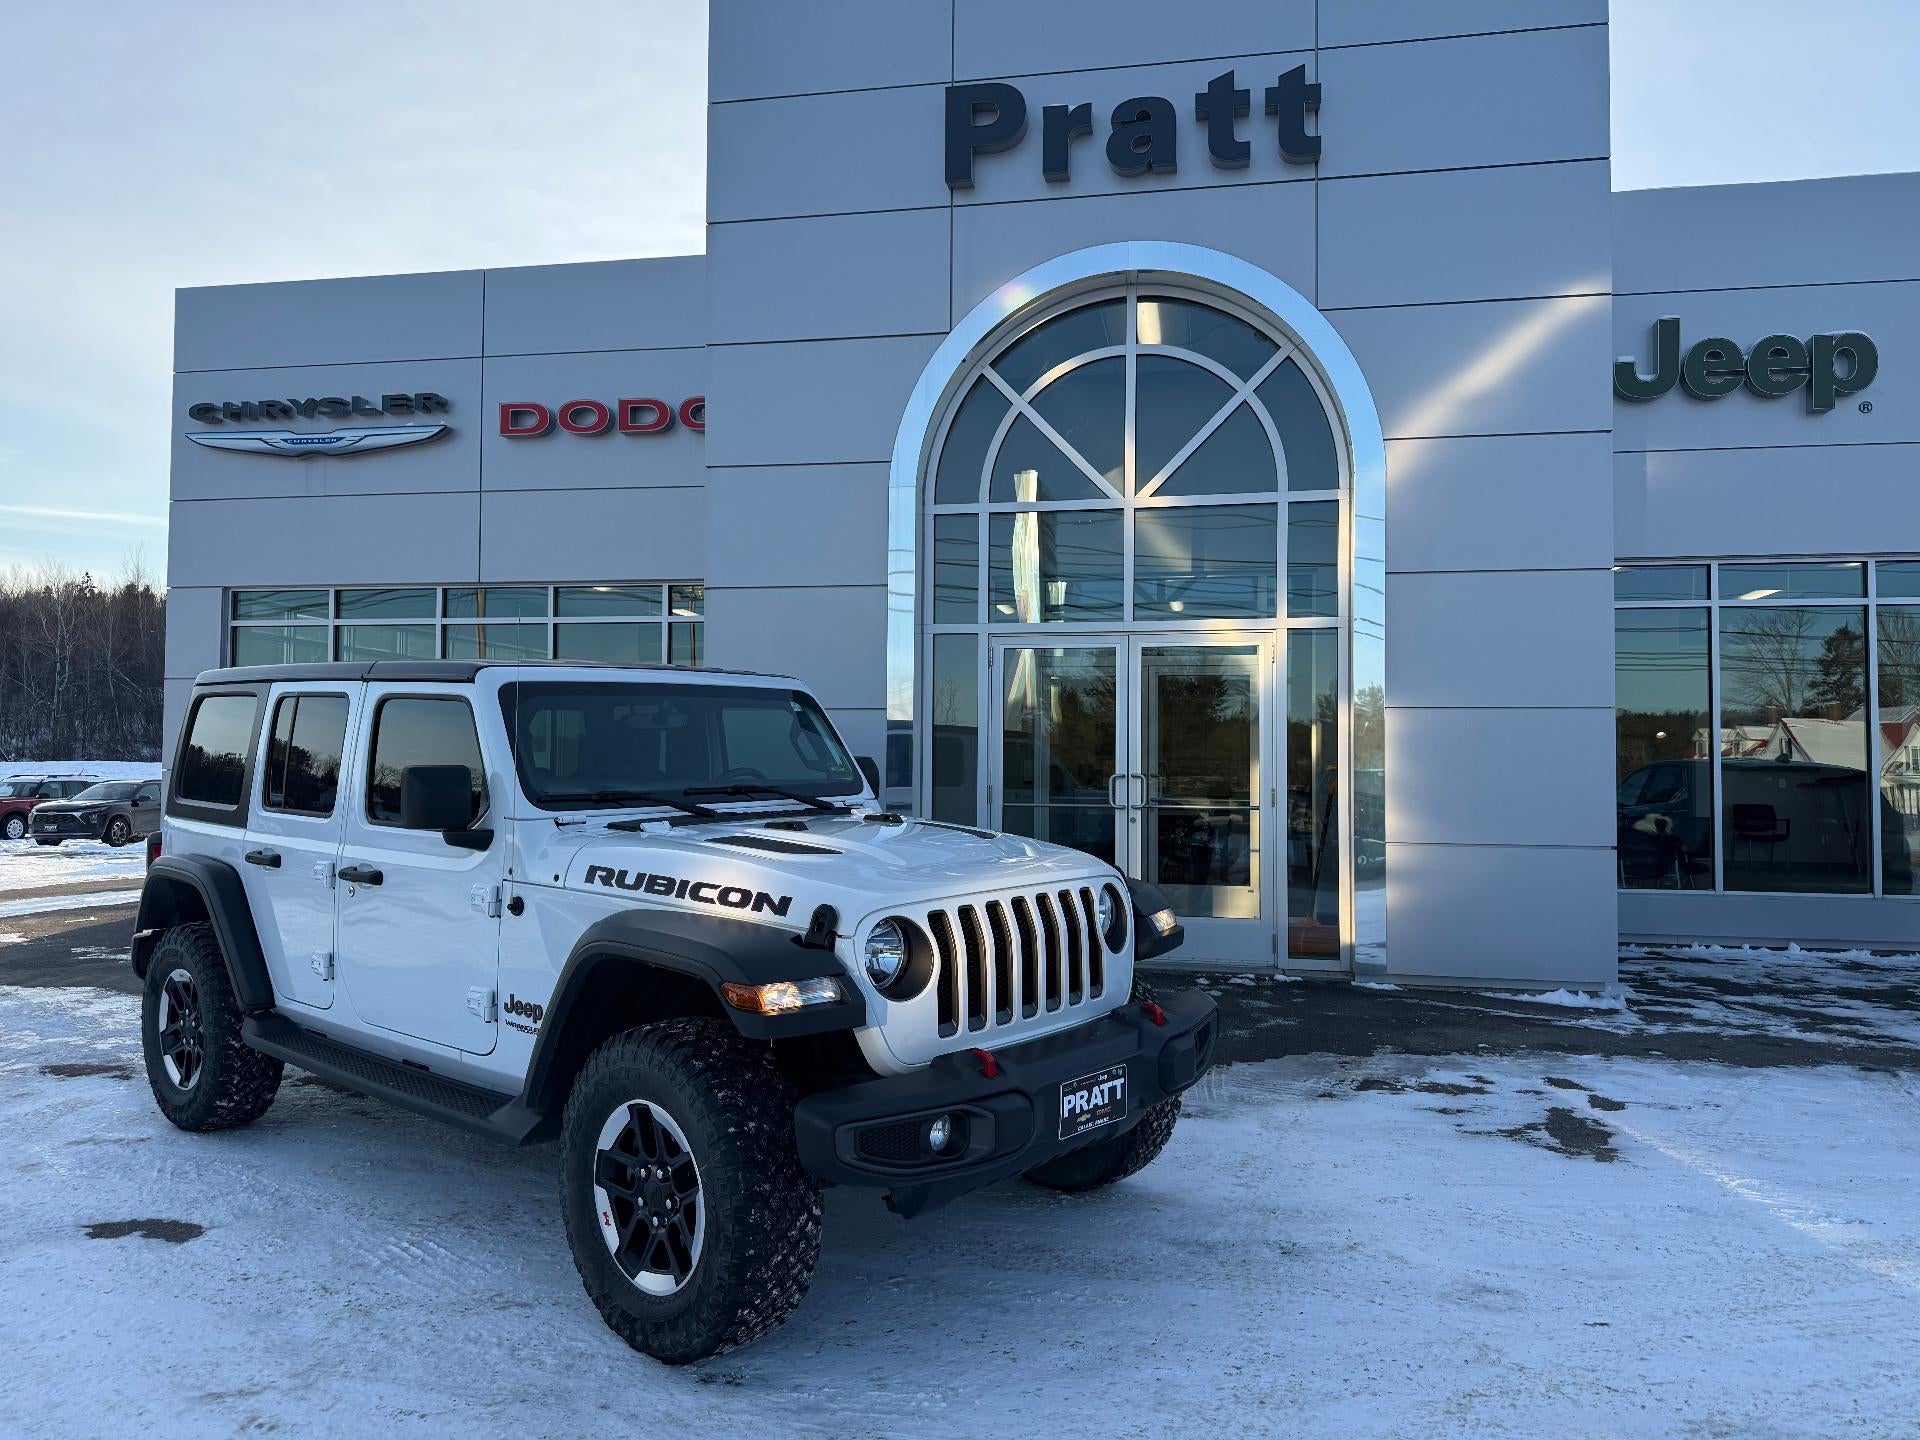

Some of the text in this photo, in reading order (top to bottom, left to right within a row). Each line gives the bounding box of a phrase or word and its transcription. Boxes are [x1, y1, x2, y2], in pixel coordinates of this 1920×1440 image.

[945, 64, 1322, 189] Pratt
[1613, 316, 1879, 414] Jeep
[188, 392, 449, 425] CHRYSLER
[584, 864, 793, 917] RUBICON
[503, 993, 543, 1024] Jeep
[1063, 1077, 1125, 1119] PRATT
